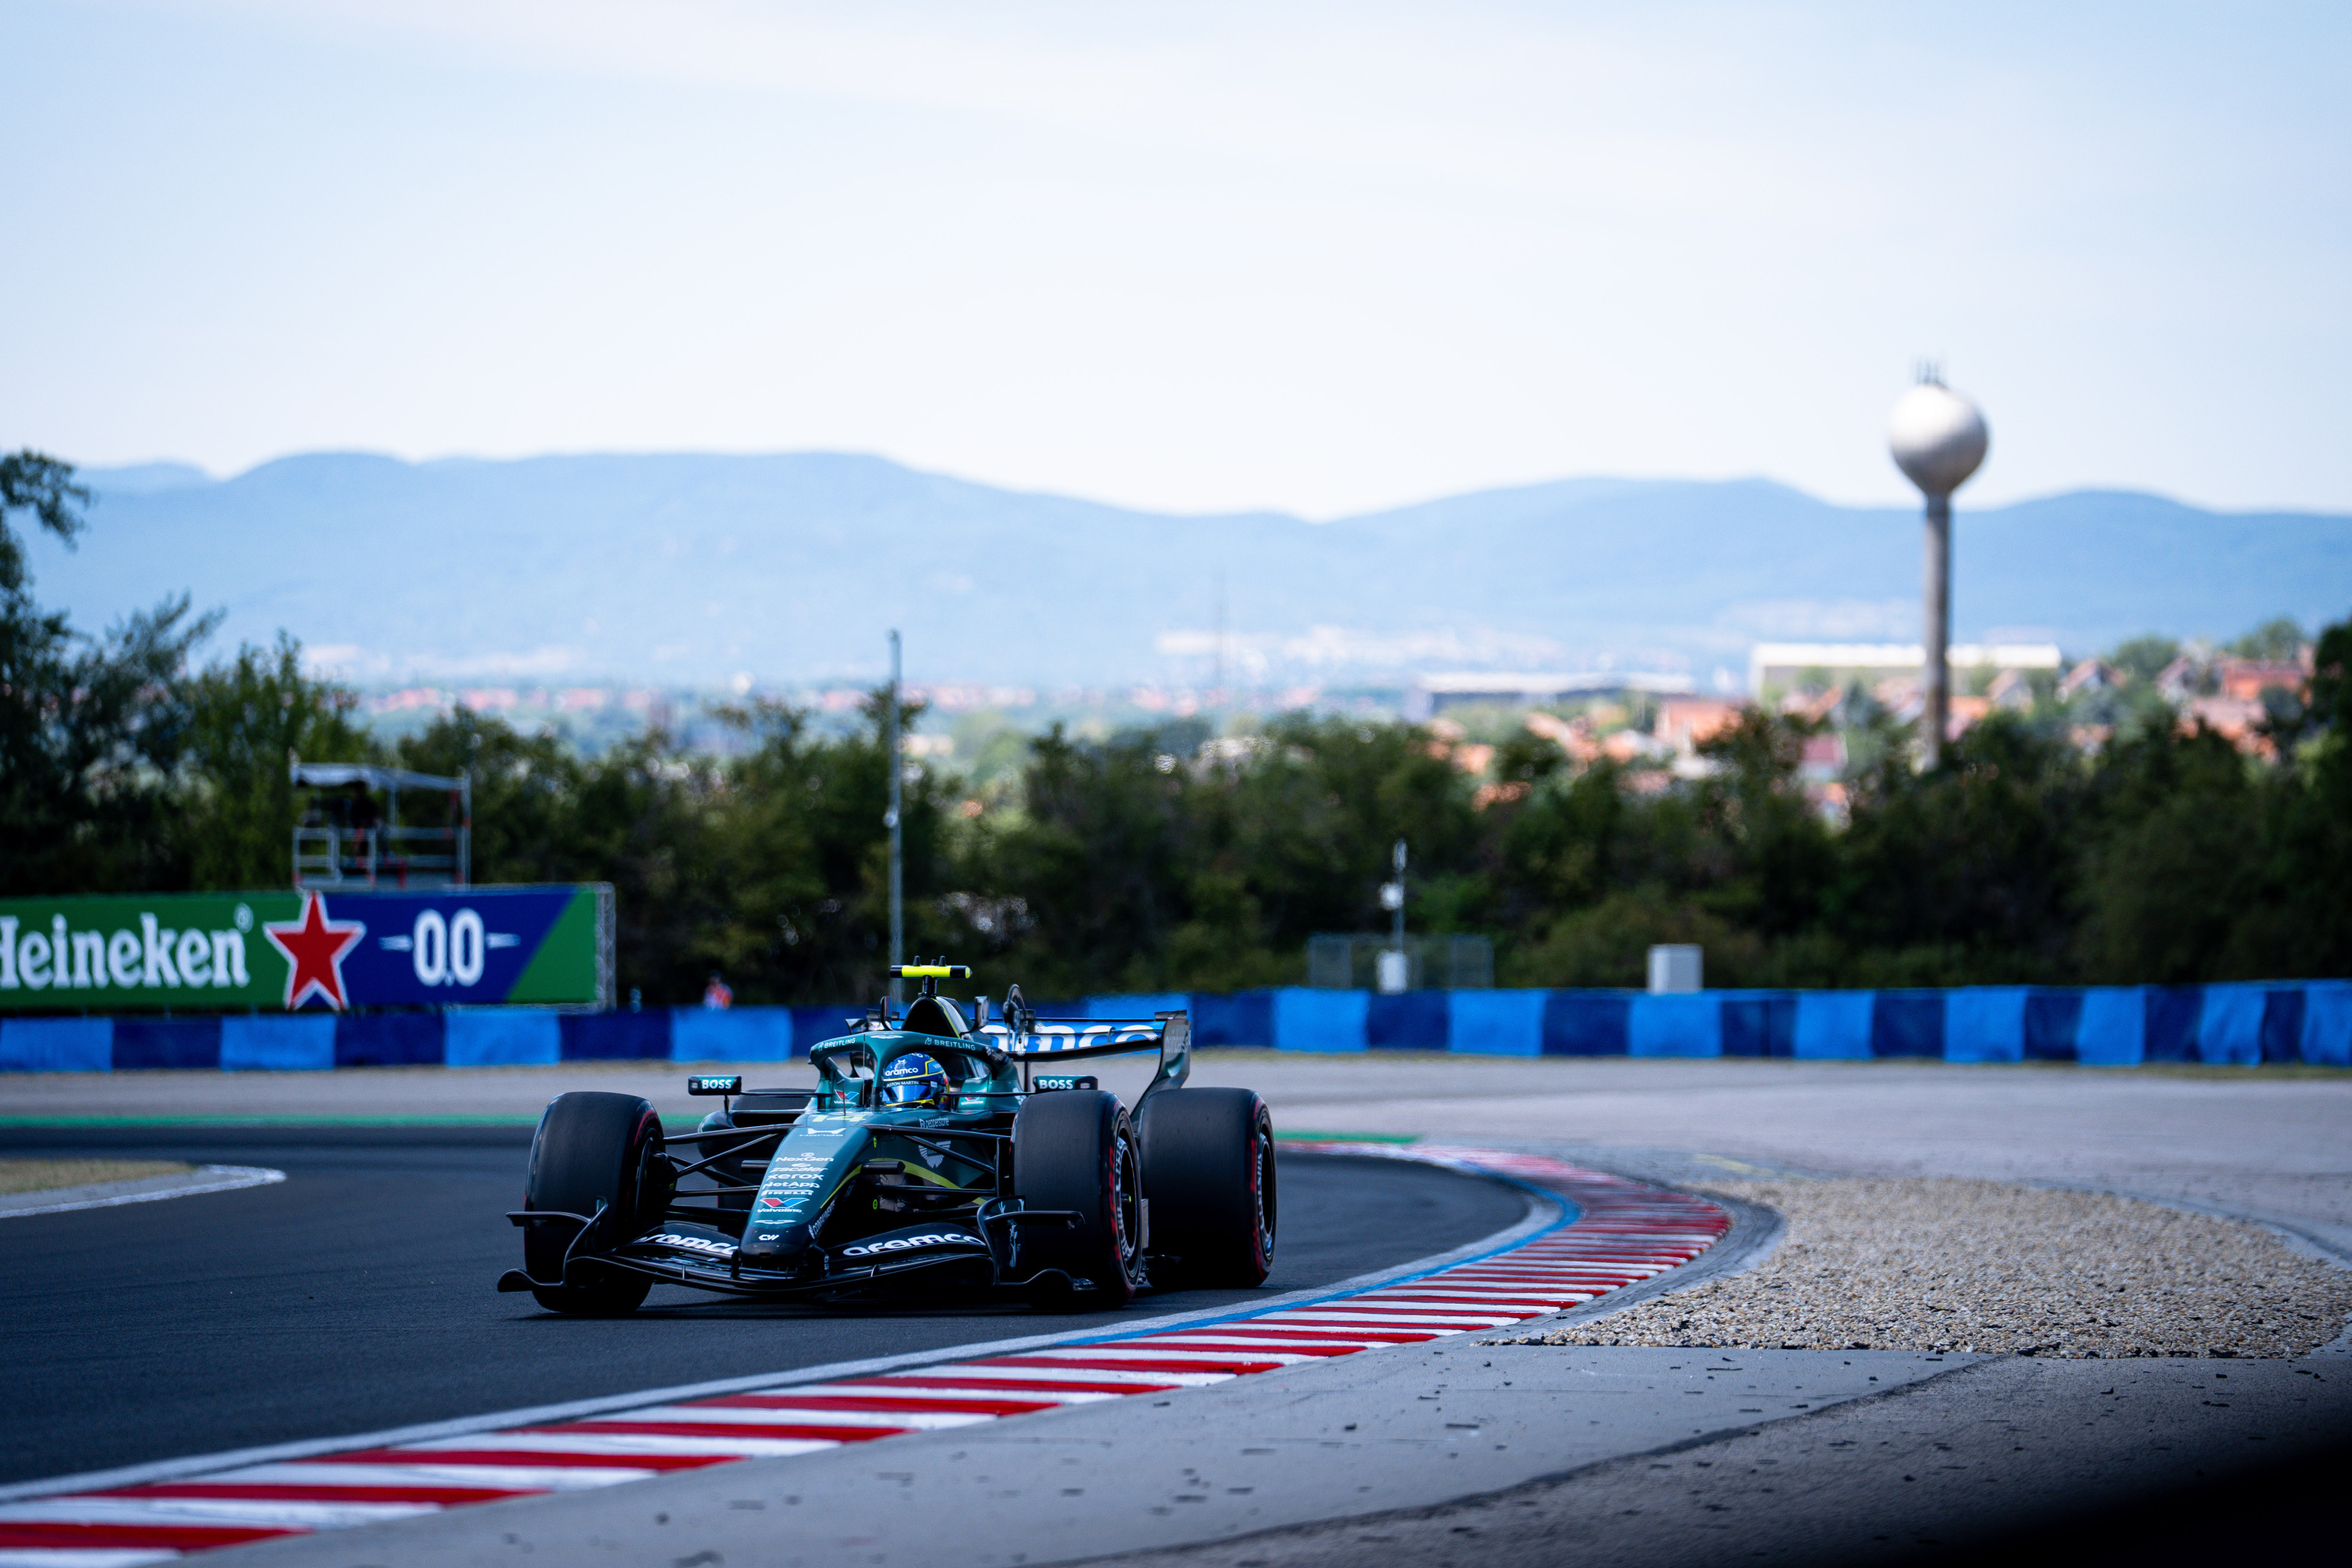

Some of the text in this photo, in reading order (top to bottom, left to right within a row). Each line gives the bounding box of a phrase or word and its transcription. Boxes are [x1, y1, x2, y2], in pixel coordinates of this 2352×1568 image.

[824, 1038, 856, 1049] BREITLING
[934, 1039, 976, 1051] BREITLING
[885, 1067, 919, 1076] aramco
[702, 1079, 732, 1089] BOSS
[1039, 1079, 1073, 1090] BOSS
[843, 1234, 986, 1256] aramco
